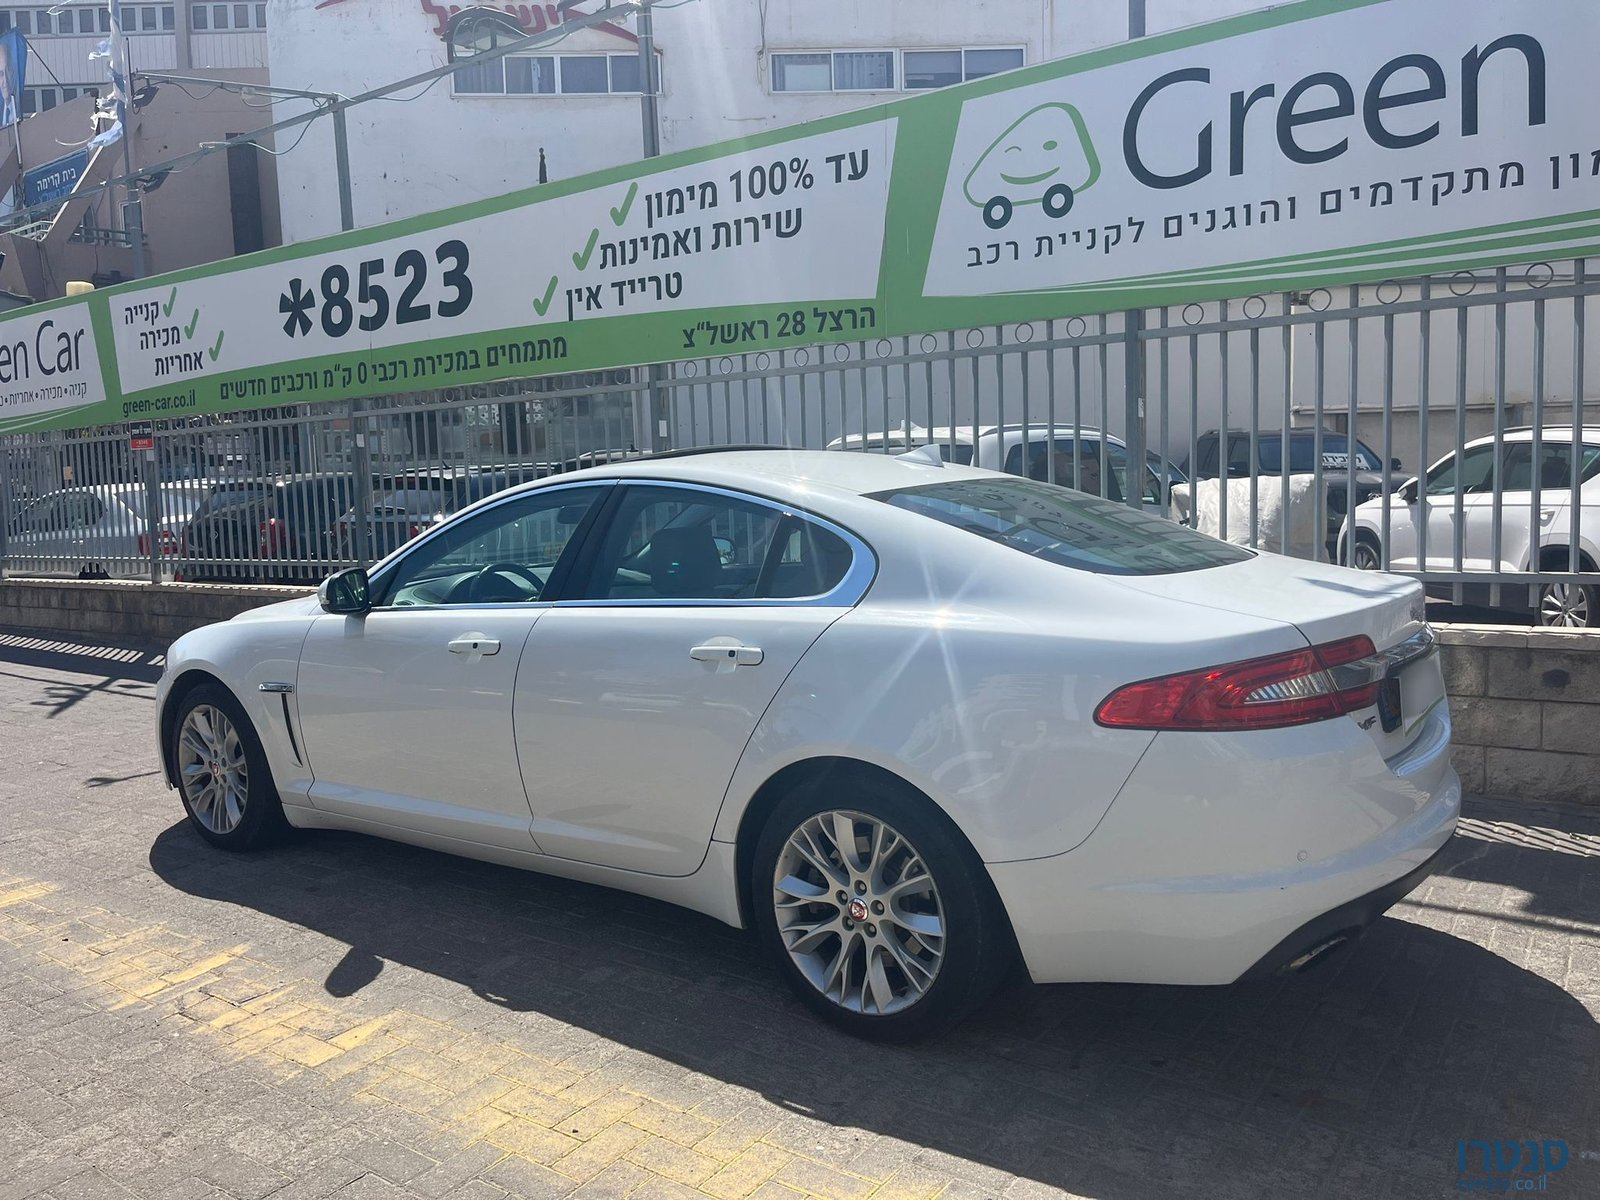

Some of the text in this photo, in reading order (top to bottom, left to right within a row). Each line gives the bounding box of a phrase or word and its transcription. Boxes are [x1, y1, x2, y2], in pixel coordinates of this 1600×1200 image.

[1123, 33, 1547, 190] Green
[62, 168, 77, 182] בית
[645, 149, 869, 228] עד 100% מימון
[1320, 161, 1524, 216] מתקדמים
[1164, 196, 1296, 239] והוגנים
[600, 207, 802, 270] שירות ואמינות
[1034, 216, 1145, 255] לקניית
[967, 240, 1019, 268] רכב
[566, 272, 683, 322] טרייד אין
[124, 301, 159, 326] קנייה
[777, 311, 806, 338] 28
[813, 306, 876, 334] הרצל
[36, 319, 84, 376] Car
[140, 326, 181, 350] מכירה
[487, 336, 567, 367] מתמחים
[155, 351, 203, 376] אחריות
[357, 361, 368, 385] 0
[372, 360, 408, 383] רכבי
[413, 349, 480, 378] במכירת
[40, 386, 63, 401] מכירה
[69, 382, 87, 399] קניה
[220, 376, 266, 400] חדשים
[271, 370, 318, 395] ורכבים
[9, 390, 35, 406] אחריות
[123, 389, 196, 418] green-car.co.il
